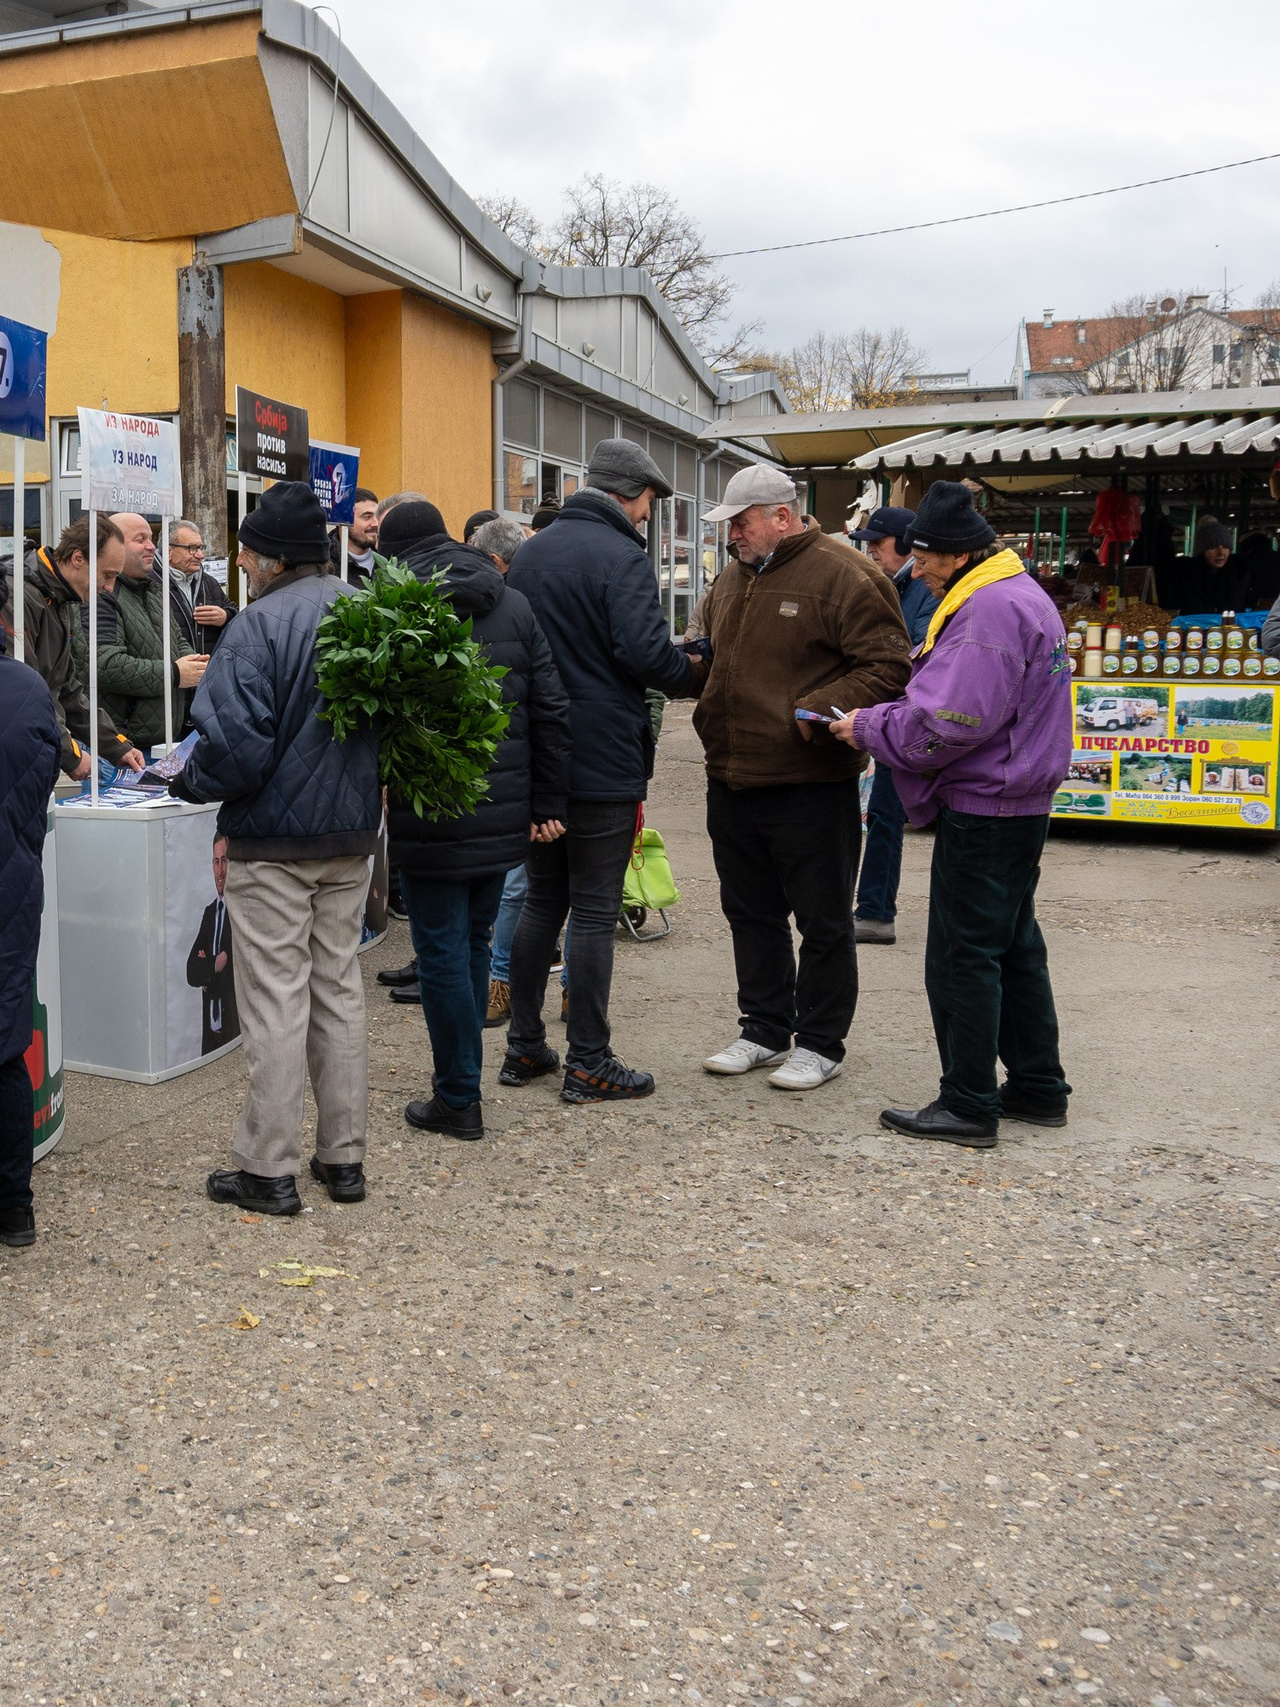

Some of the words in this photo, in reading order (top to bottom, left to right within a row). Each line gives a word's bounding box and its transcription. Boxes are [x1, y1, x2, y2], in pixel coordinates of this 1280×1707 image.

[104, 413, 118, 430] ИЗ
[120, 416, 160, 438] НАРОДА
[254, 400, 288, 436] Србија
[256, 432, 286, 455] против
[112, 448, 124, 465] УЗ
[127, 451, 158, 472] НАРОД
[256, 454, 287, 476] насиља
[111, 487, 125, 504] ЗА
[127, 489, 159, 510] НАРОД
[1081, 736, 1210, 755] ПЧЕЛАРСТВО
